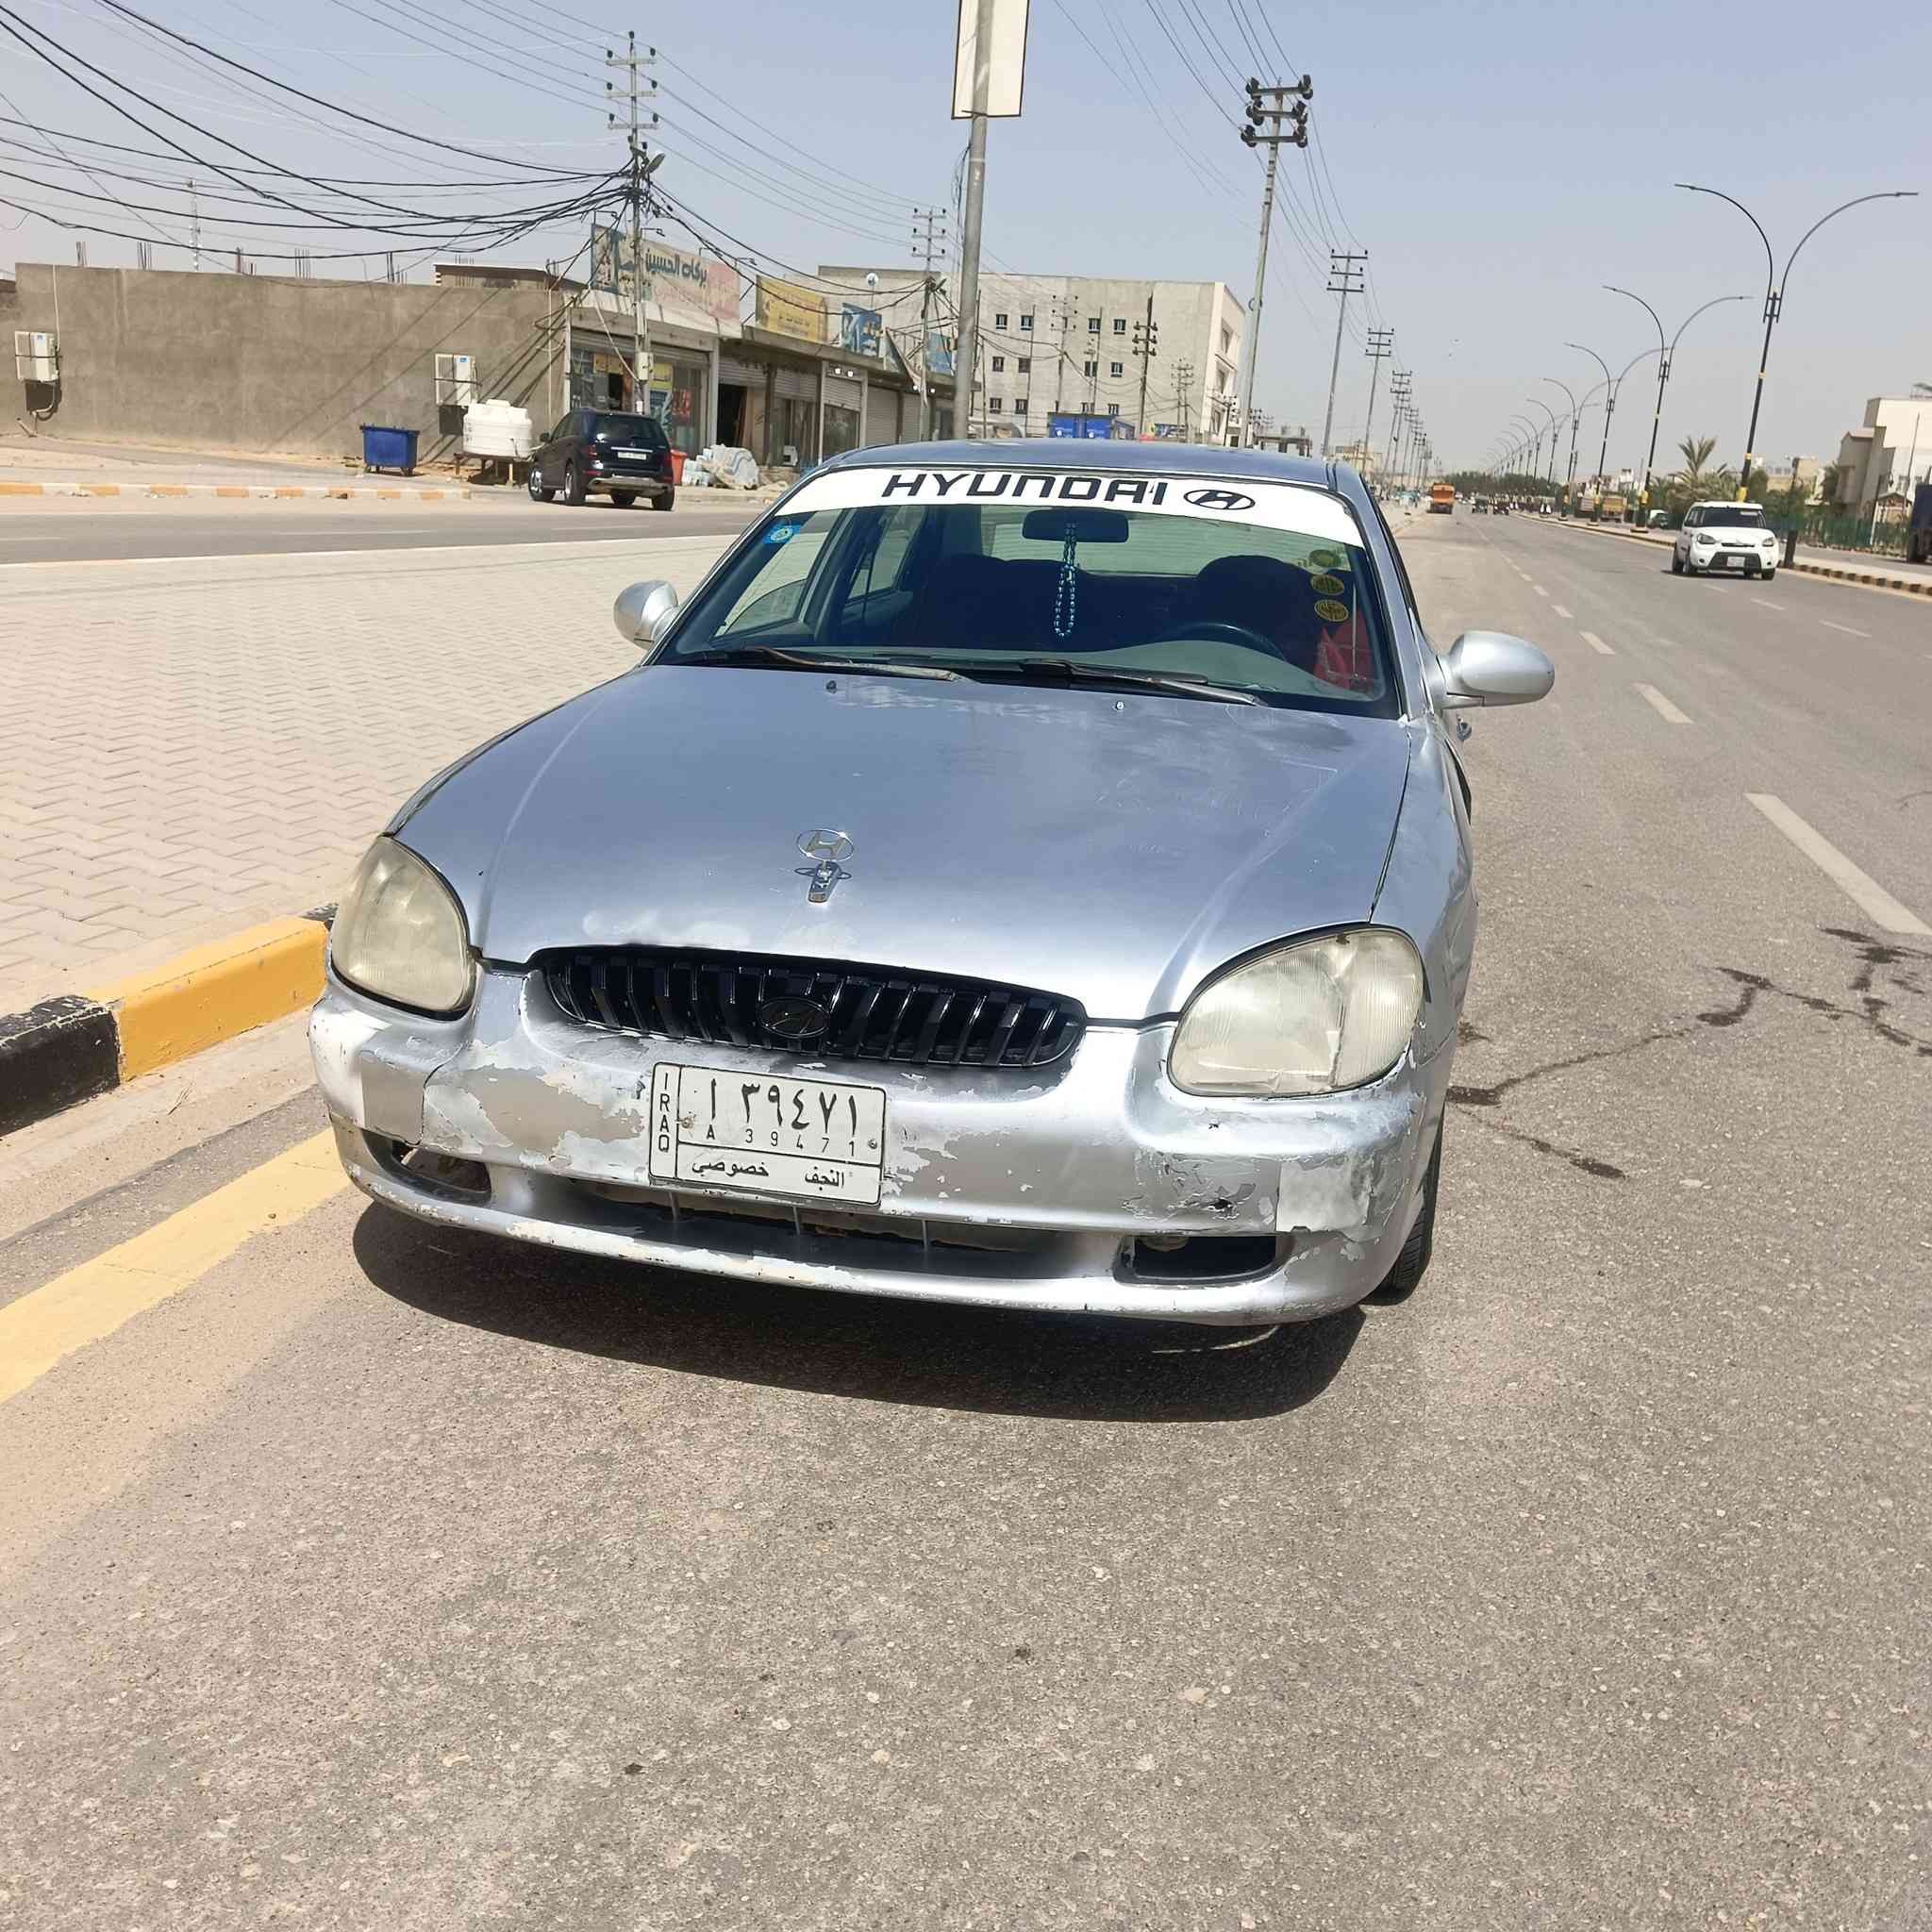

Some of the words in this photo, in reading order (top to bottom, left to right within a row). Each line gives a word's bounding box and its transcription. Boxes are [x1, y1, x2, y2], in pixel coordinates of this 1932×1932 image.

[645, 248, 680, 275] الحسين
[881, 473, 1169, 506] HYUNDAI
[658, 1072, 671, 1153] IRAQ
[691, 1160, 770, 1178] خصوصي
[804, 1166, 845, 1191] النجف
